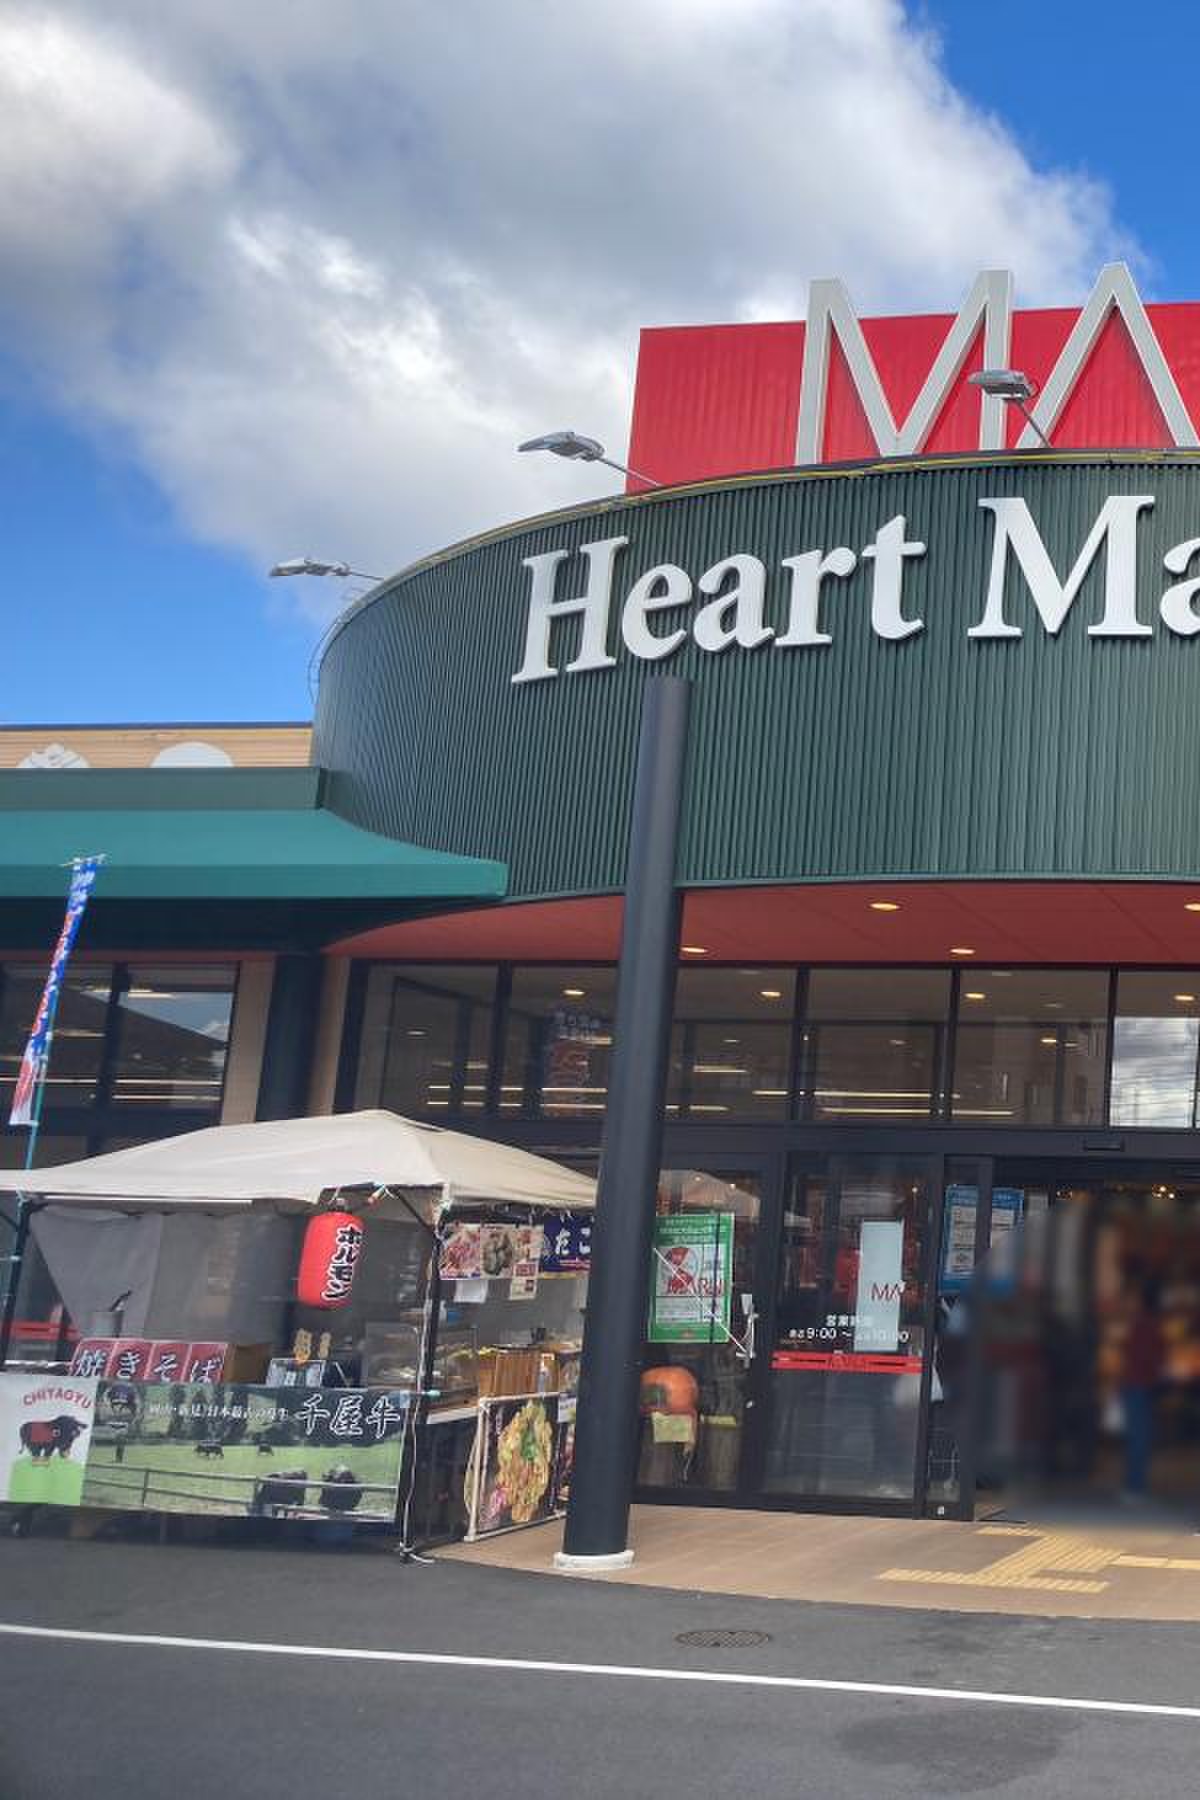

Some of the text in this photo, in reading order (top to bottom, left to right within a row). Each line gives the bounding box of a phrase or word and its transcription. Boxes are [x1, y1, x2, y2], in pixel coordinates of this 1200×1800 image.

[510, 515, 926, 684] Heart
[321, 1225, 363, 1300] ホルモン
[74, 1350, 224, 1384] 焼きそば
[295, 1393, 401, 1439] 千屋牛
